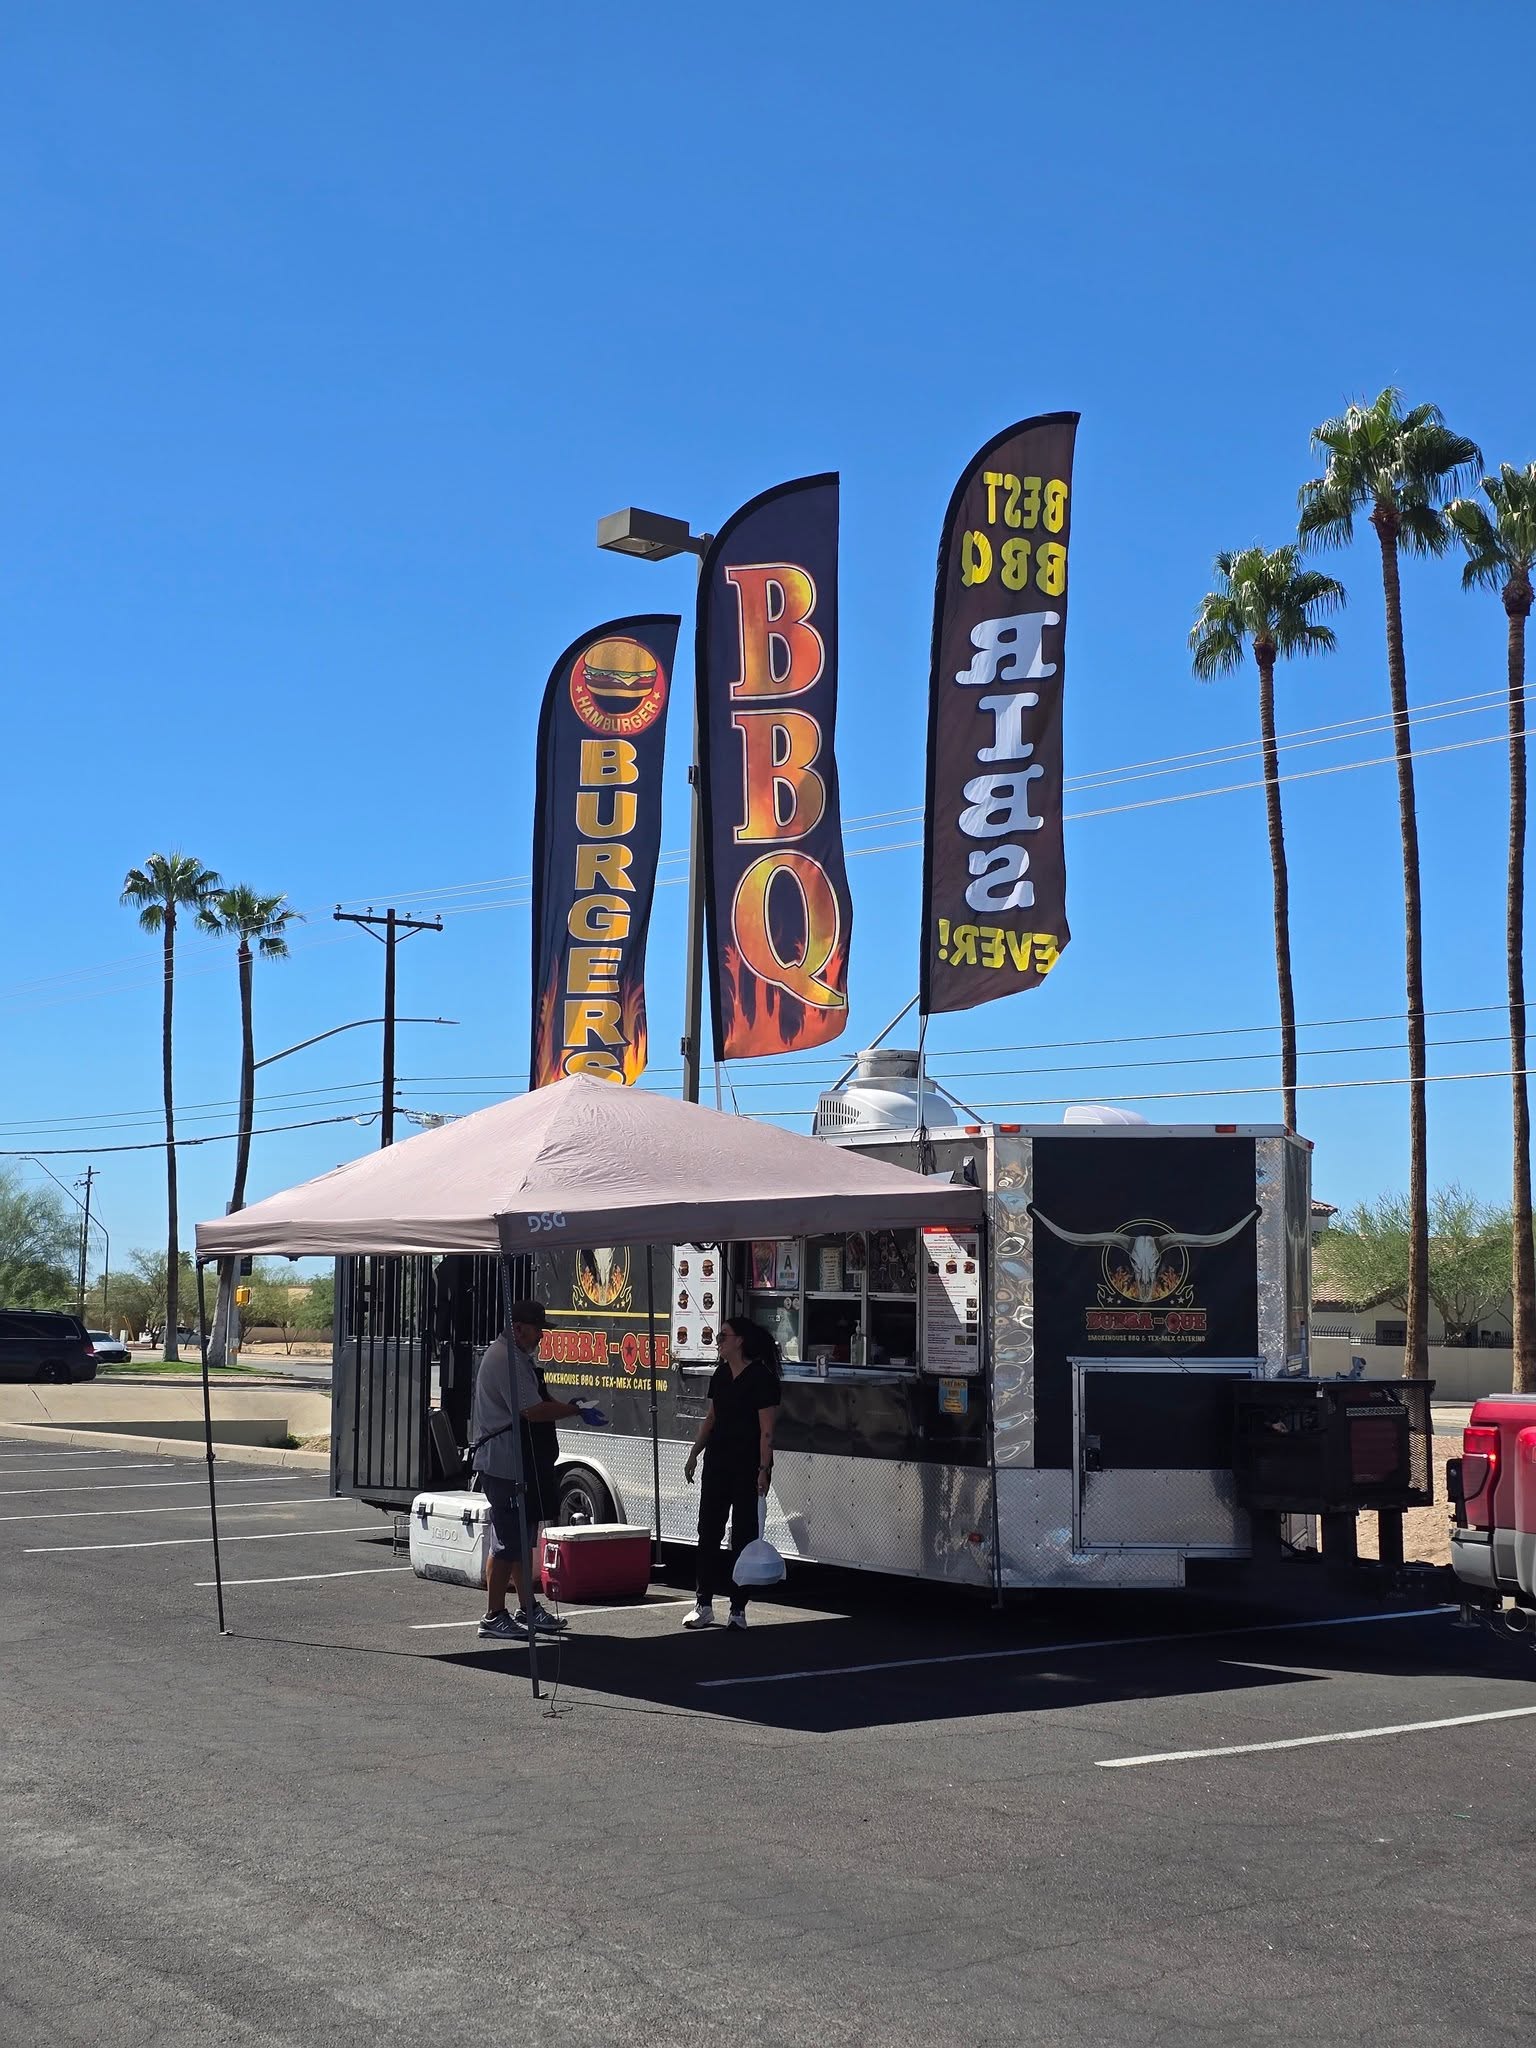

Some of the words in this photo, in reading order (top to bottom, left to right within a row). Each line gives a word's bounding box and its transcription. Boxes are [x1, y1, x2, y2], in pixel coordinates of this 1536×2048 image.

[577, 696, 658, 731] HAMBURGER
[725, 562, 846, 1010] BBQ
[527, 1211, 567, 1232] DSG
[1086, 1311, 1207, 1334] BUBBA-QUE
[537, 1328, 670, 1375] BUBBA-QUE
[543, 1371, 579, 1386] MOKEHOUSE
[580, 1374, 594, 1387] BBQ
[601, 1375, 632, 1390] TEX-MEX
[633, 1378, 668, 1392] CATEING
[432, 1526, 459, 1542] IGLOO
